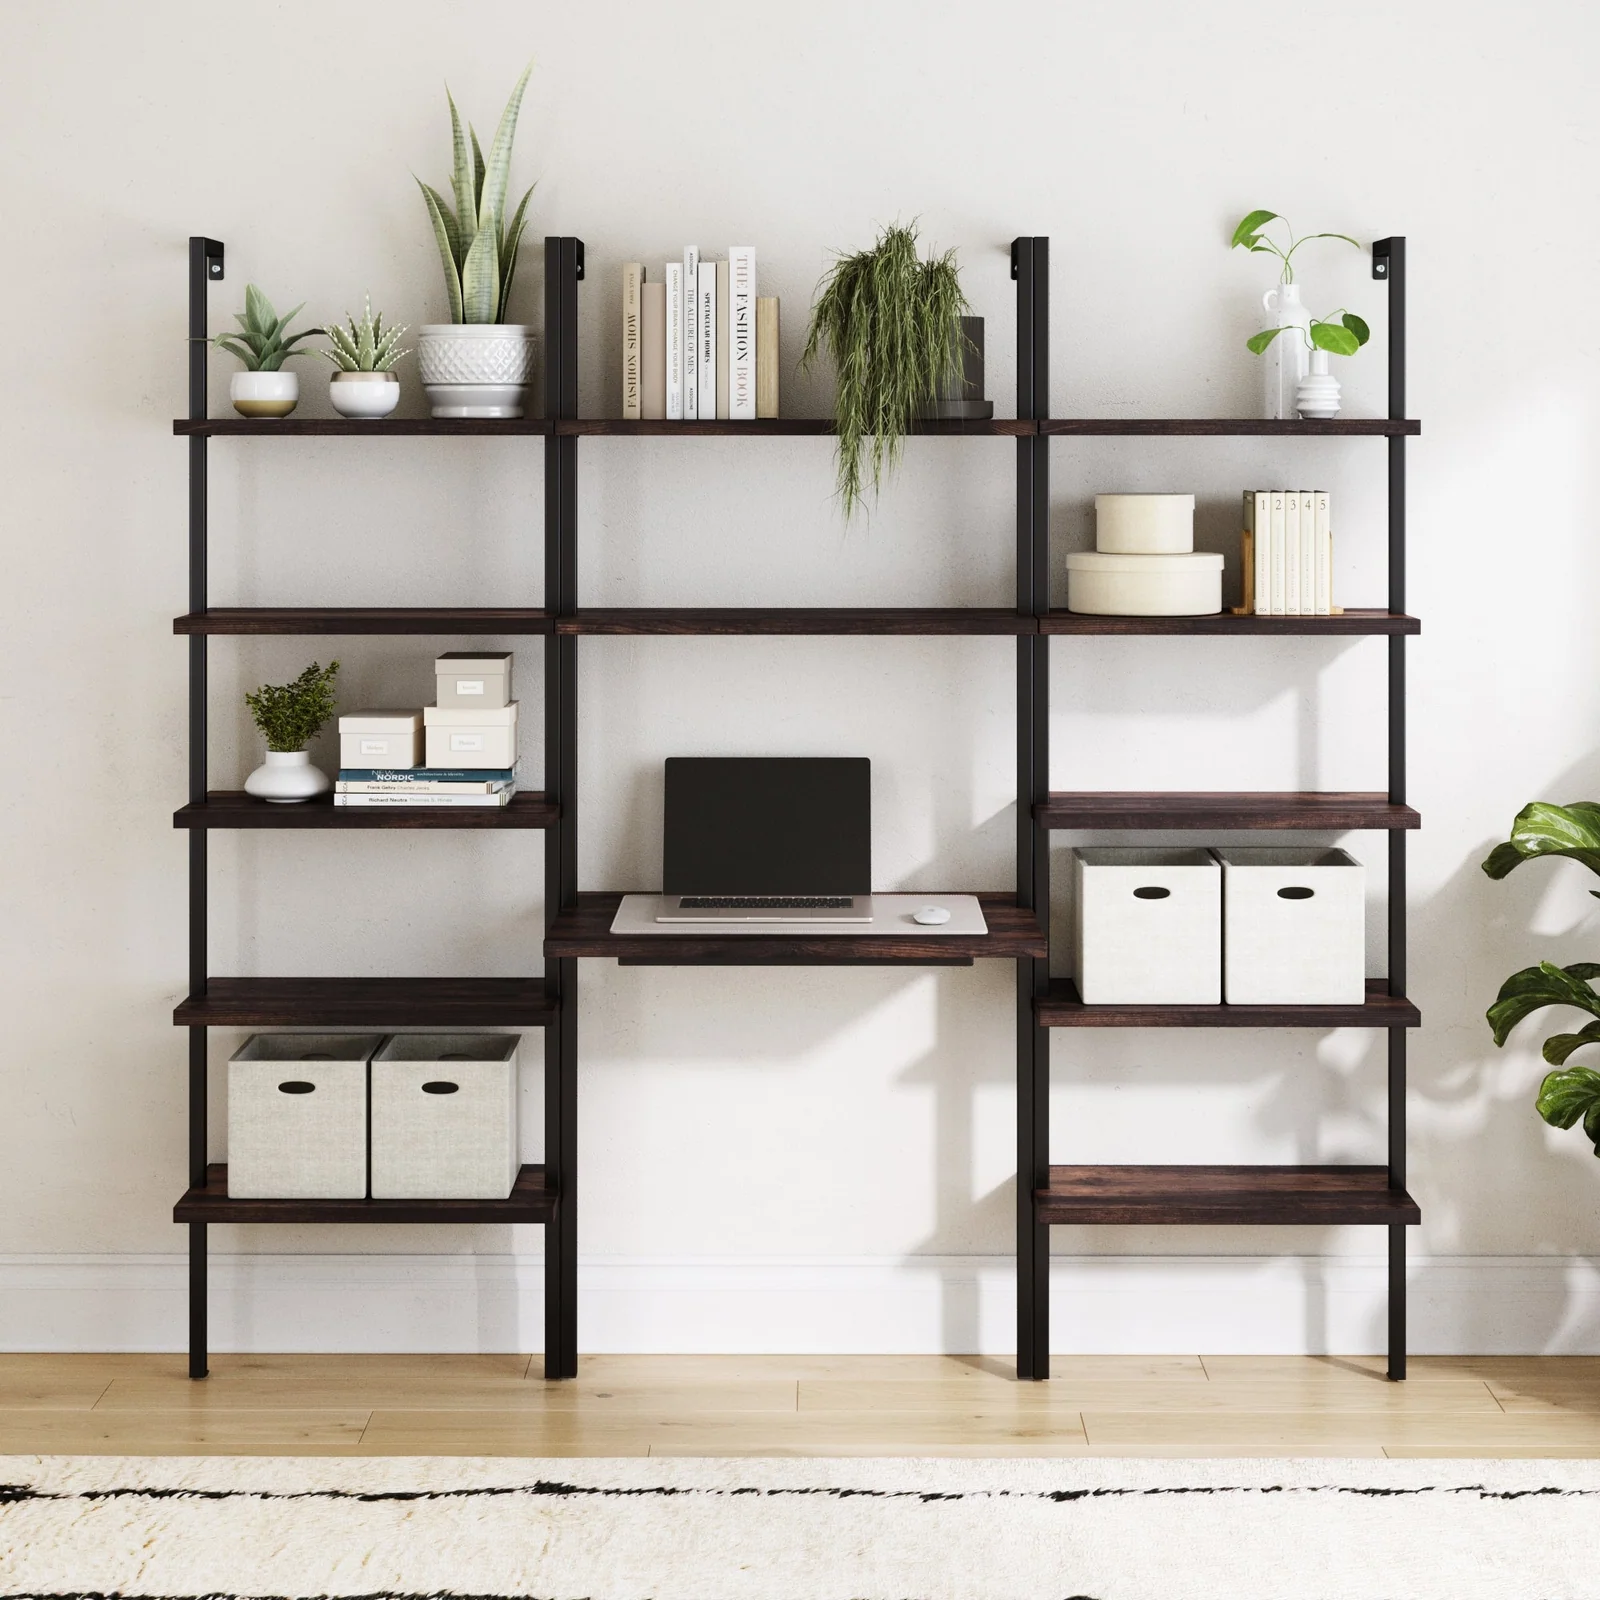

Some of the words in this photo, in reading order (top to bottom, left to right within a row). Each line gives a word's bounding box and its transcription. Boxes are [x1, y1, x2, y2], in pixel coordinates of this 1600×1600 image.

[736, 255, 748, 288] THE
[627, 312, 637, 349] SHOW
[736, 294, 748, 361] FASHION
[687, 342, 694, 354] OF
[627, 355, 637, 408] FASHION
[736, 367, 748, 407] BOOK
[1261, 499, 1266, 511] 1
[1275, 499, 1282, 511] 2
[1290, 499, 1296, 511] 3
[1305, 499, 1311, 511] 4
[1320, 499, 1326, 511] 5
